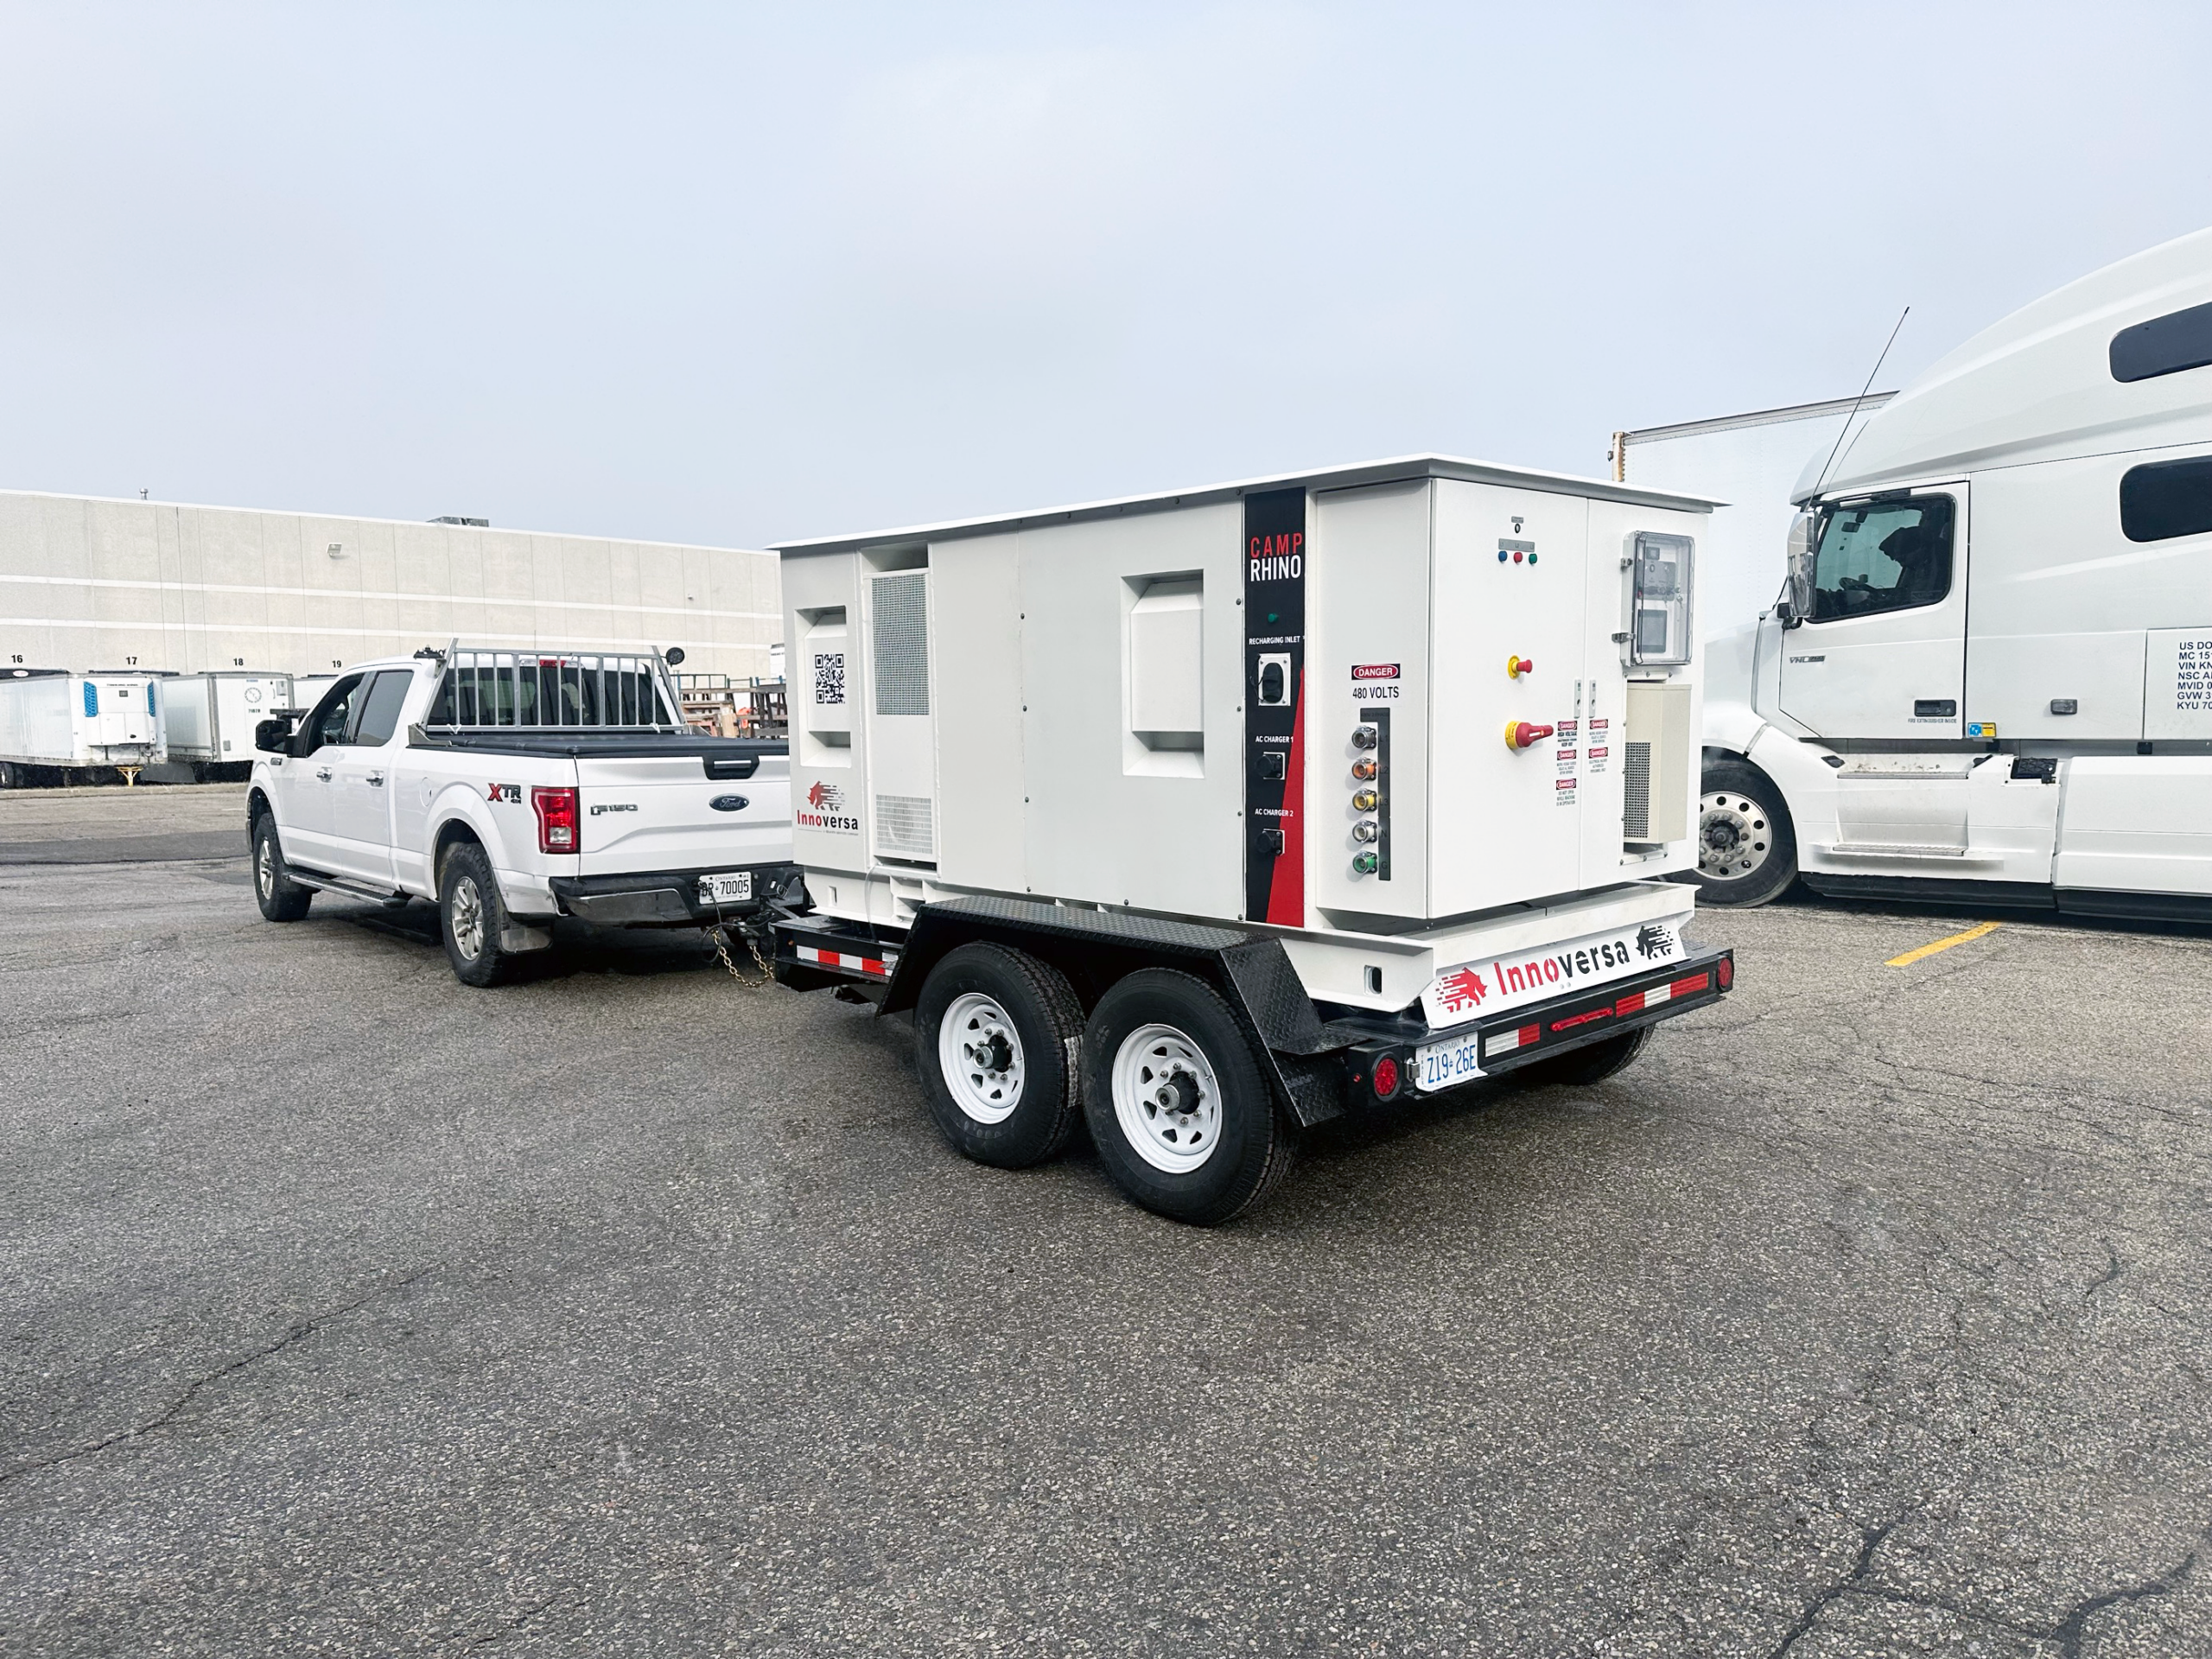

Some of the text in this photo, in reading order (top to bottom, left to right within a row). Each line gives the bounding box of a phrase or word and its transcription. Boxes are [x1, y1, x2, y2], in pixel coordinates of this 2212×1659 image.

[1250, 532, 1302, 558] CAMP
[1250, 555, 1301, 582] RHINO
[1249, 636, 1284, 645] RECHARGING
[1284, 635, 1300, 644] INLET
[10, 654, 23, 664] 16
[2178, 651, 2212, 660] MC 15
[125, 657, 137, 665] 17
[233, 658, 244, 666] 18
[332, 659, 342, 668] 19
[1357, 667, 1393, 677] DANGER
[2177, 671, 2212, 680] NSC A
[1352, 686, 1400, 699] 480 VOLTS
[2177, 691, 2212, 700] GVW 3
[487, 782, 522, 803] XTR
[719, 798, 741, 808] Ford
[1263, 808, 1289, 817] CHARGER
[797, 810, 859, 830] Innoversa
[720, 880, 749, 895] 70005
[1493, 940, 1630, 996] Innoversa
[1435, 1039, 1460, 1053] ONTARIO
